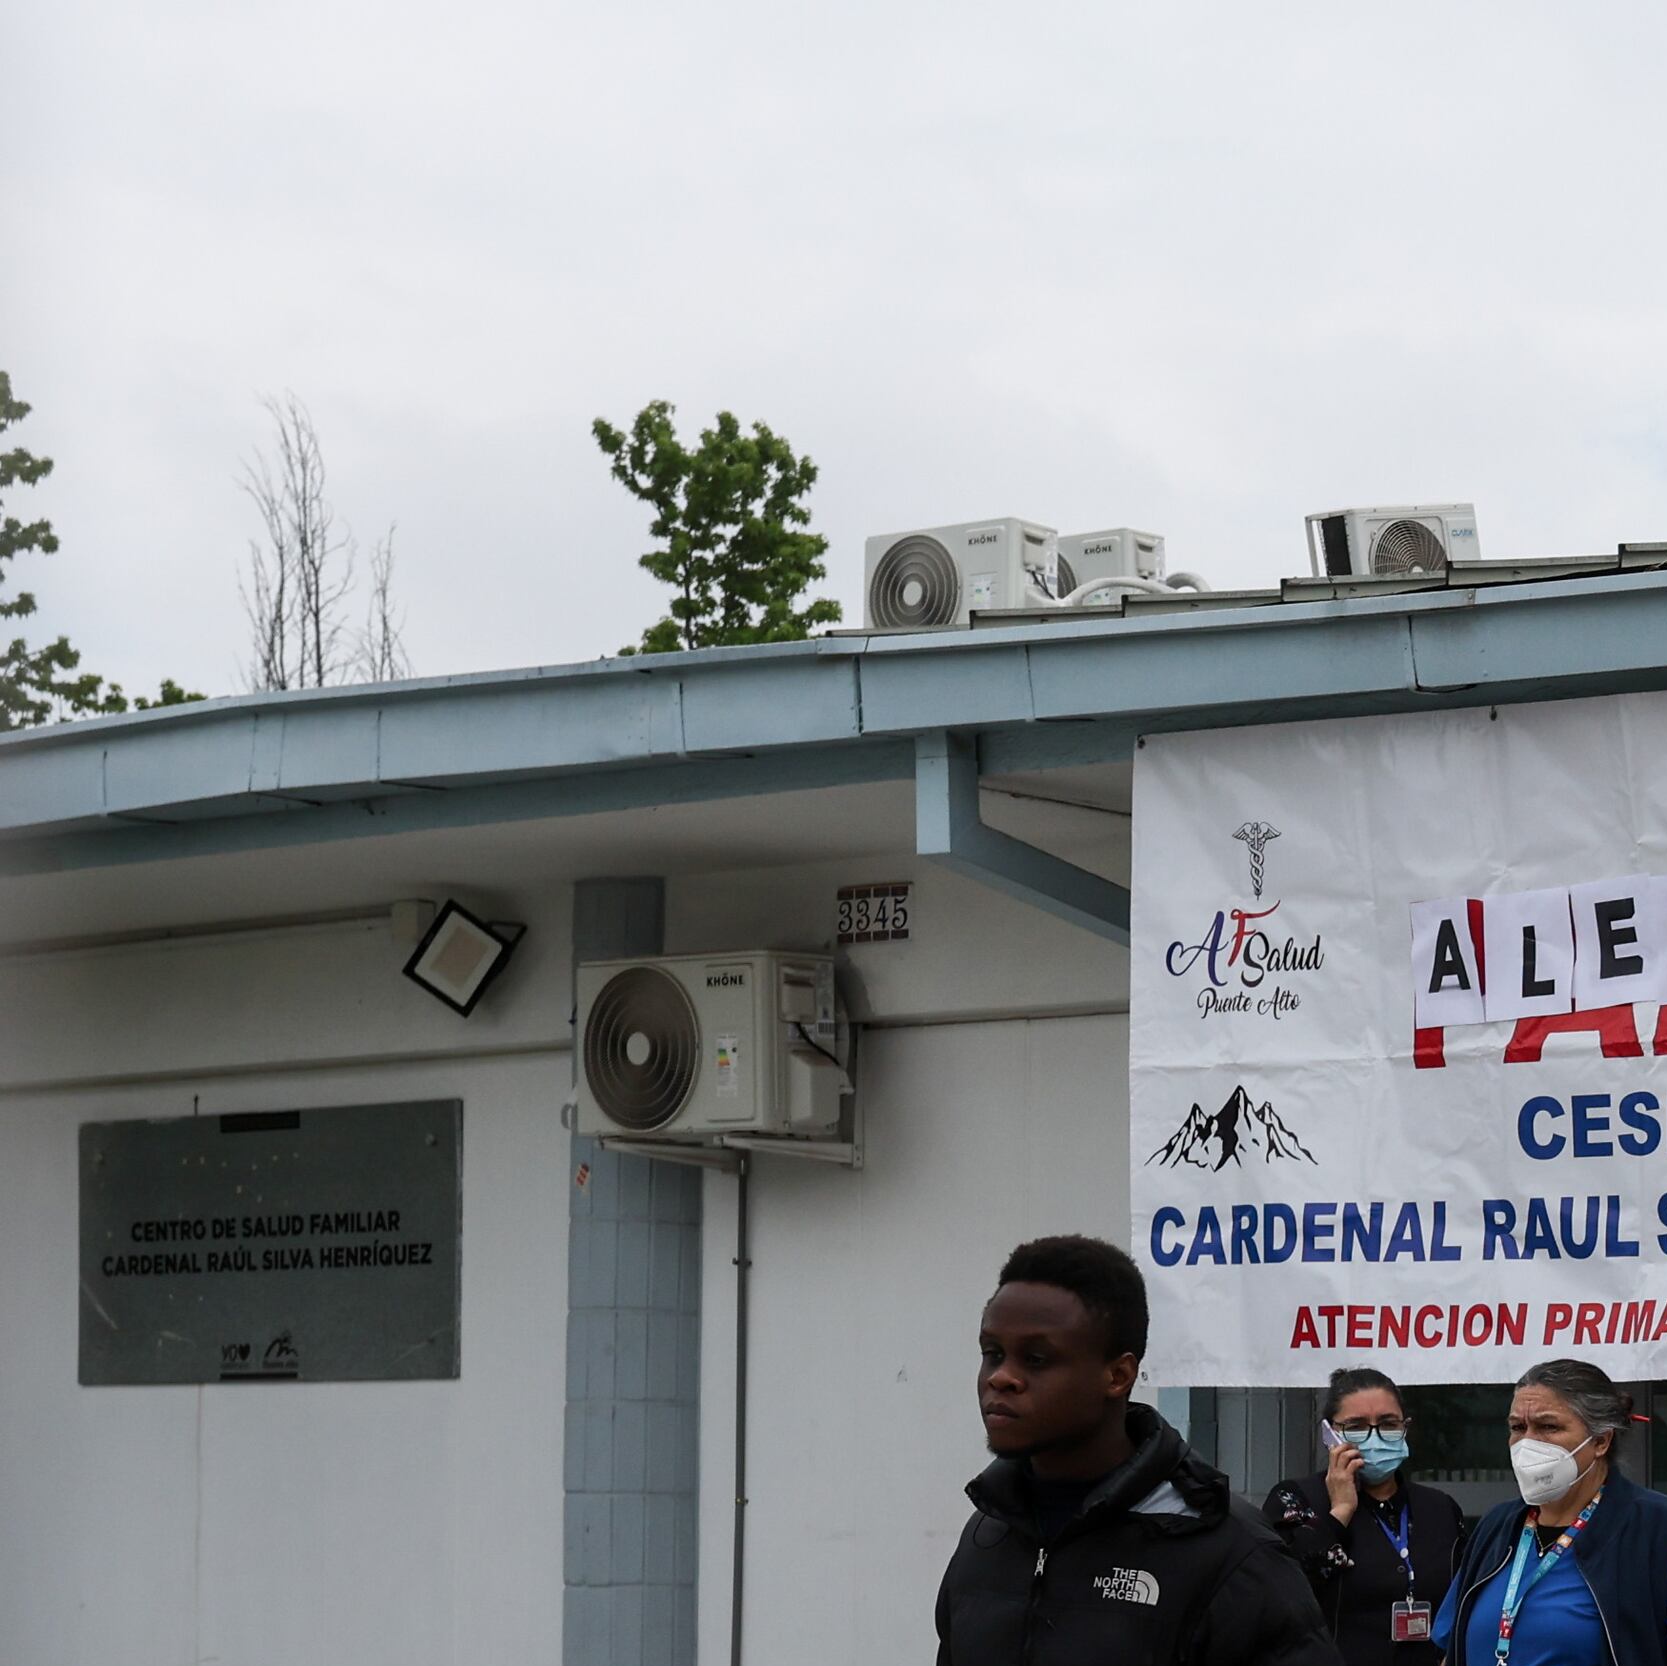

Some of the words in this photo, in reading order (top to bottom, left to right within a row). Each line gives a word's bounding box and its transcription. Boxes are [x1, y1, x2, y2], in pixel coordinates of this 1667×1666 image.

[838, 897, 909, 934] 3345
[1242, 934, 1325, 988] Salud
[1197, 988, 1252, 1020] Puente
[1257, 985, 1302, 1021] Alto
[131, 1219, 206, 1243] CENTRO
[211, 1218, 237, 1240] DE
[242, 1214, 305, 1239] SALUD
[309, 1210, 401, 1235] FAMILIAR
[1150, 1201, 1462, 1268] CARDENAL
[1481, 1195, 1640, 1261] RAUL
[102, 1254, 202, 1277] CARDENAL
[207, 1246, 257, 1273] RAÚL
[262, 1249, 314, 1272] SILVA
[319, 1239, 433, 1269] HENRÍQUEZ
[1290, 1302, 1528, 1349] ATENCION
[1093, 1576, 1135, 1591] NORTH
[1112, 1567, 1138, 1580] THE
[1102, 1588, 1133, 1601] FACE
